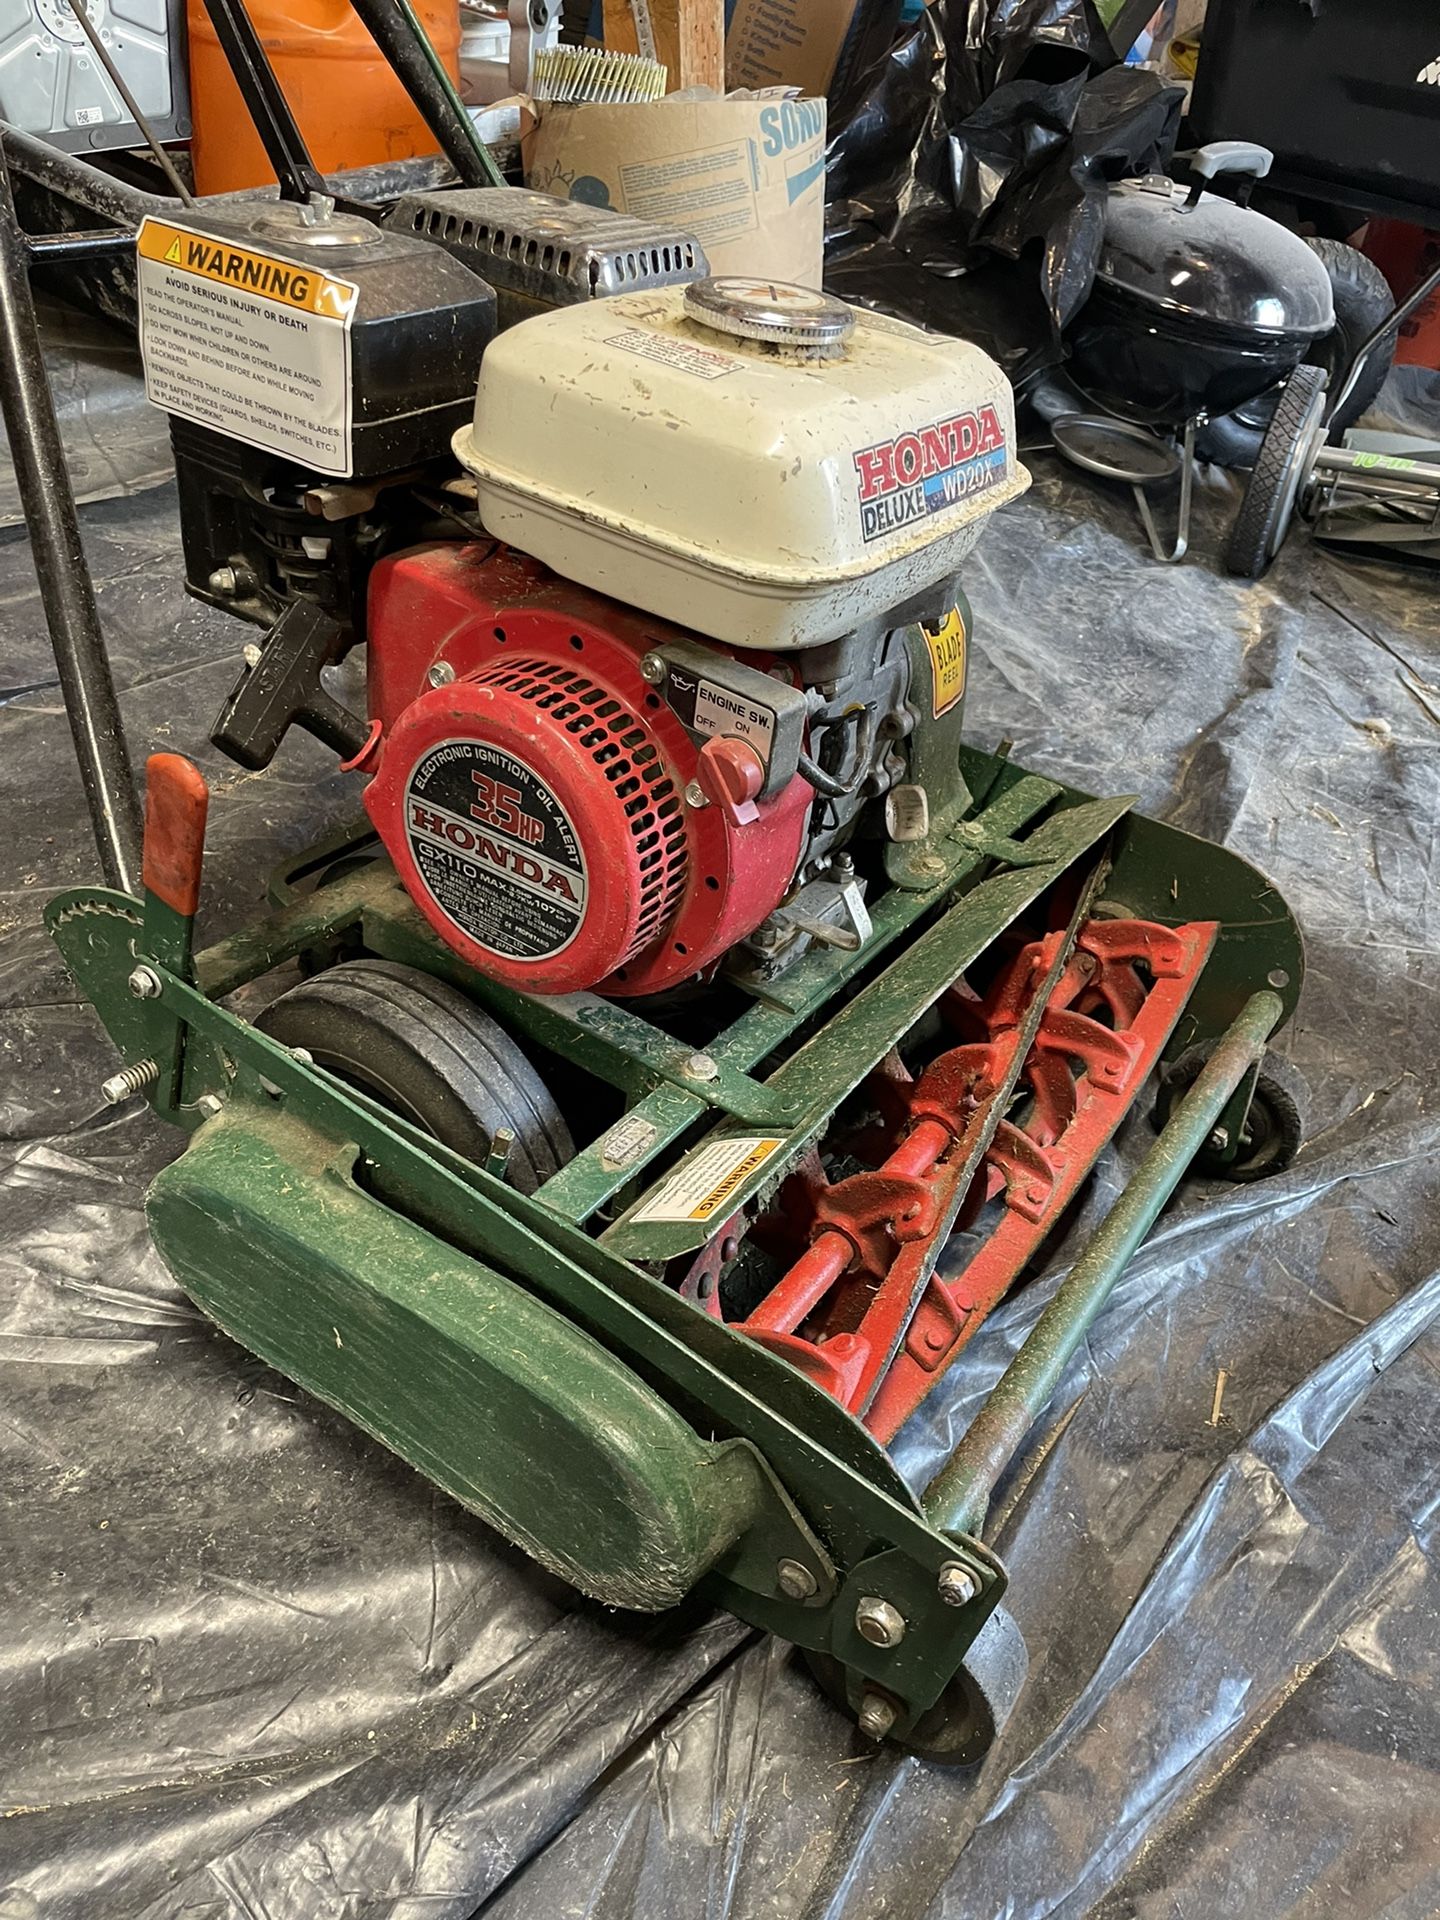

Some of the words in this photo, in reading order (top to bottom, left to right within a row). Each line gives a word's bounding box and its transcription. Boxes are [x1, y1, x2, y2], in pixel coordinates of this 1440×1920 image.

[146, 286, 162, 298] READ
[163, 292, 175, 303] THE
[187, 240, 309, 302] WARNING
[148, 304, 157, 312] GO
[158, 307, 182, 321] ACROSS
[210, 325, 223, 336] NOT
[224, 330, 233, 339] UP
[234, 333, 247, 344] AND
[165, 276, 189, 292] AVOID
[191, 285, 227, 305] SERIOUS
[230, 298, 260, 316] INJURY
[264, 309, 276, 321] OR
[279, 314, 308, 332] DEATH
[150, 319, 158, 328] DO
[159, 322, 171, 333] NOT
[173, 327, 186, 339] MOW
[187, 332, 206, 346] WHEN
[208, 340, 239, 358] CHILDREN
[240, 351, 250, 362] OR
[251, 356, 277, 372] OTHERS
[279, 366, 292, 377] ARE
[150, 335, 166, 347] LOOK
[167, 341, 186, 354] DOWN
[187, 348, 199, 359] AND
[201, 353, 224, 369] BEHIND
[226, 362, 250, 378] BEFORE
[252, 372, 265, 384] AND
[267, 377, 287, 392] WHILE
[288, 385, 314, 402] MOVING
[151, 362, 175, 377] REMOVE
[176, 371, 203, 388] OBJECTS
[204, 382, 220, 394] THAT
[222, 388, 242, 403] COULD
[244, 397, 252, 407] BE
[254, 401, 281, 418] THROWN
[283, 412, 291, 421] BY
[295, 416, 306, 427] THE
[153, 378, 168, 390] KEEP
[170, 385, 191, 399] SAFETY
[193, 393, 217, 409] DEVICES
[161, 392, 180, 405] PLACE
[181, 400, 193, 410] AND
[856, 405, 1004, 500] HONDA
[863, 486, 925, 535] DELUXE
[936, 632, 960, 670] BLADE
[696, 714, 716, 728] OFF
[735, 721, 750, 734] ON
[699, 687, 746, 718] ENGINE
[749, 711, 770, 729] SW.
[415, 746, 472, 791] ELECTRONIC
[475, 748, 530, 785] IGNITION
[536, 789, 553, 813] OIL
[554, 816, 580, 866] ALERT
[412, 803, 579, 904] HONDA
[418, 842, 476, 879] GX110
[480, 873, 510, 890] MAX.
[534, 899, 556, 914] 107
[700, 1155, 762, 1211] WARNING
